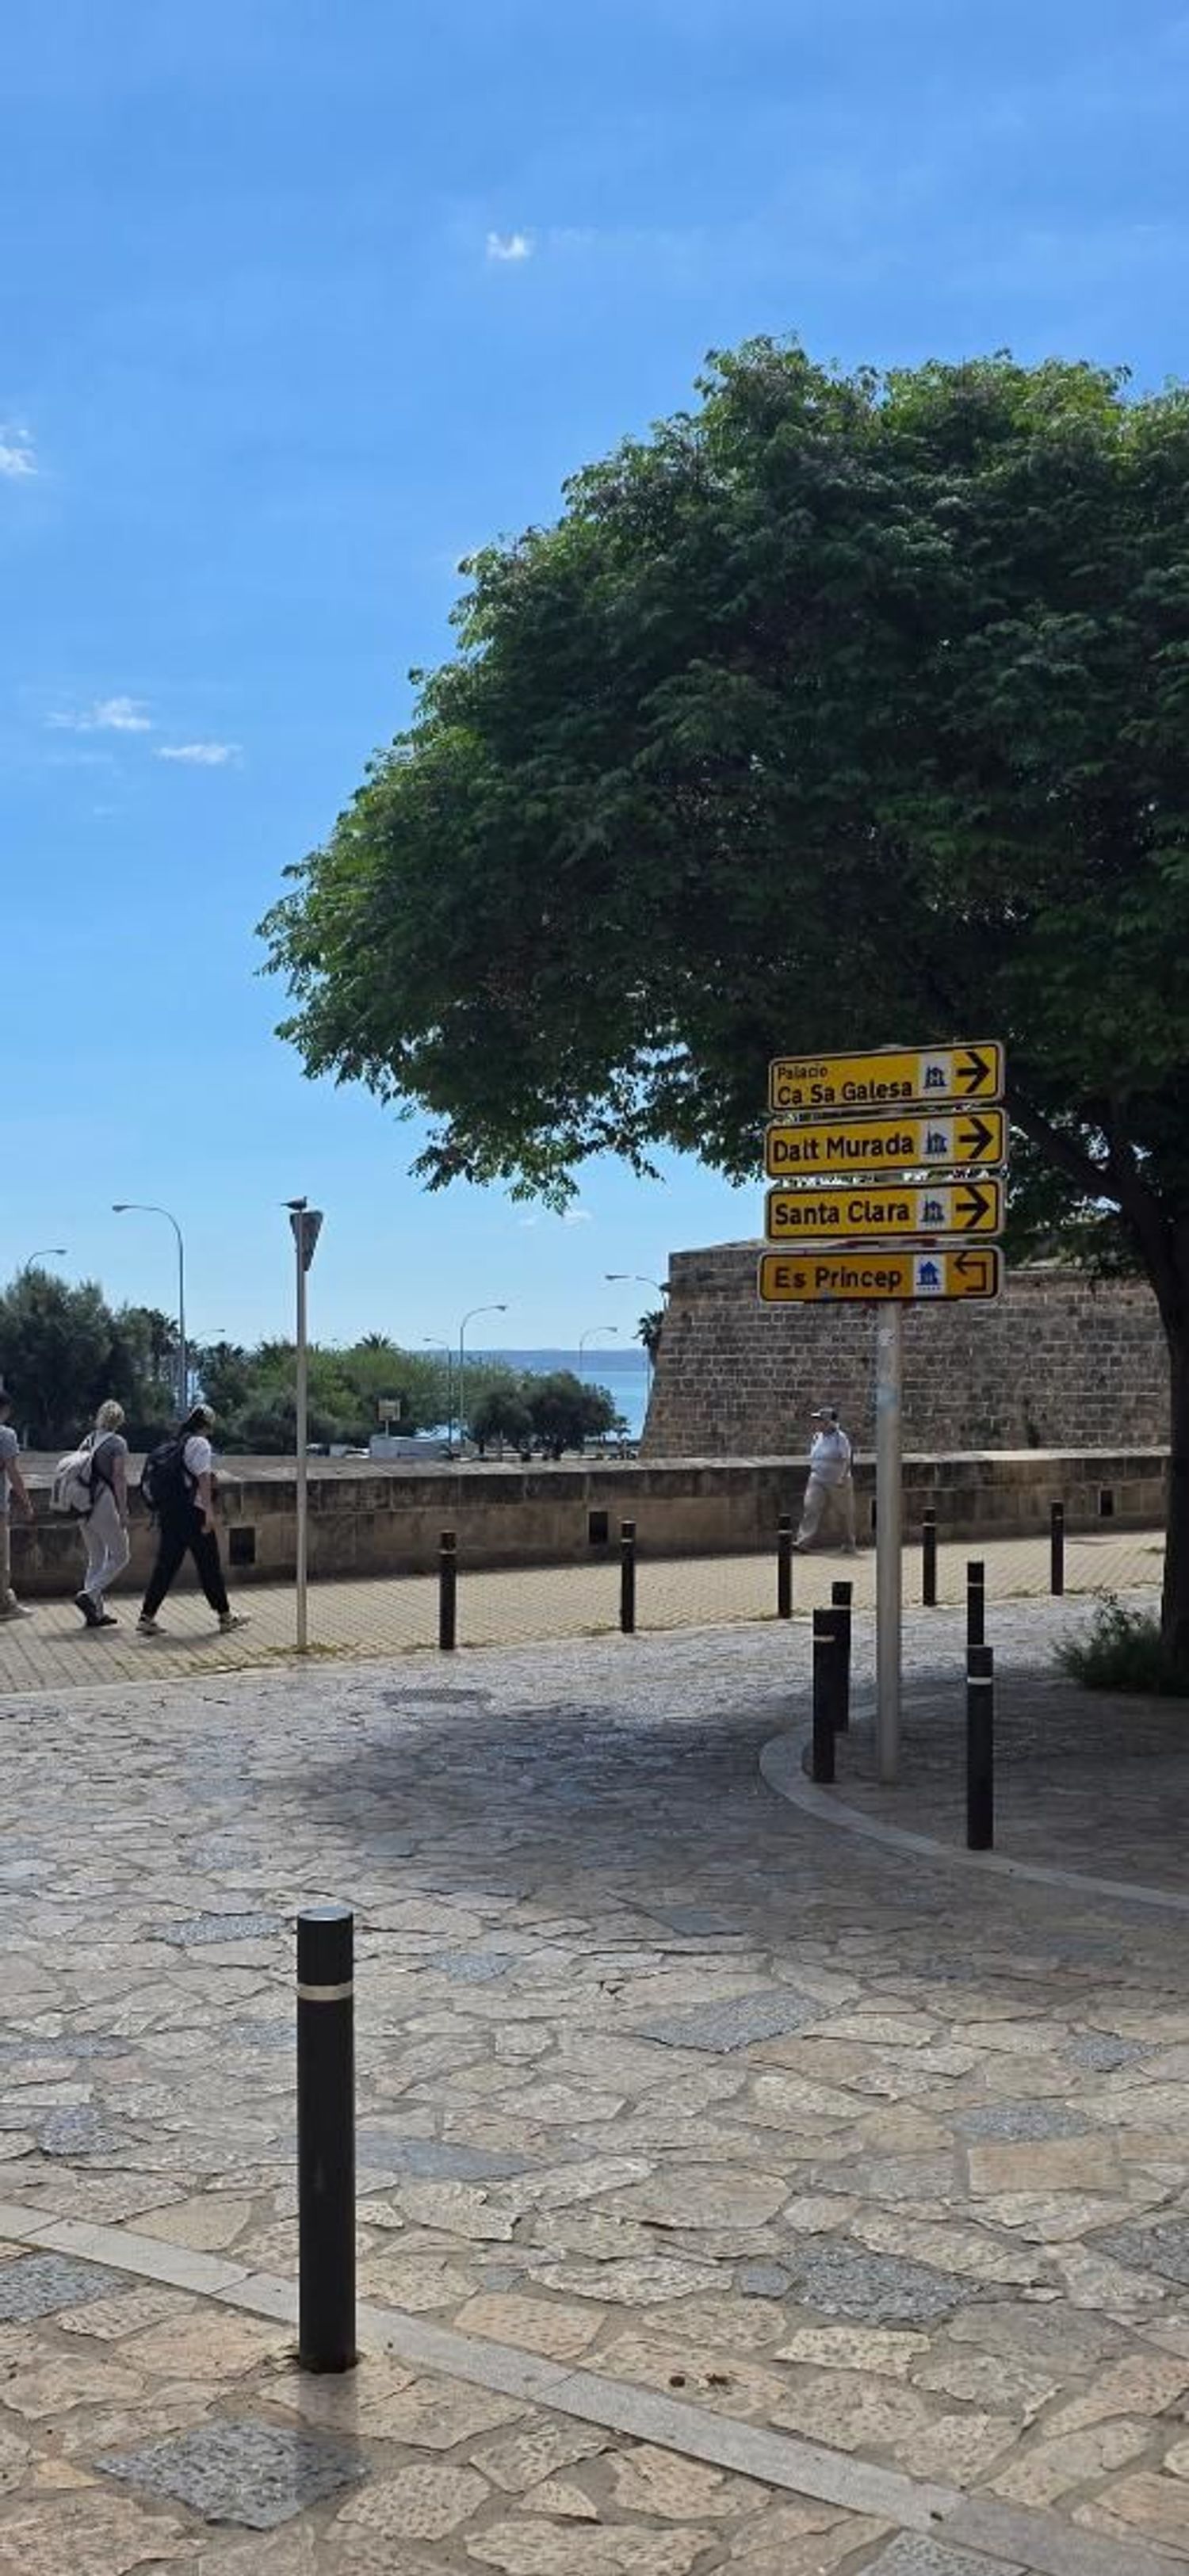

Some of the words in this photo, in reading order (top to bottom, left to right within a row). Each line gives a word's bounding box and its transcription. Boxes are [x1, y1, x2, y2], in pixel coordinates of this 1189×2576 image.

[778, 1064, 828, 1080] Palacio
[778, 1086, 802, 1105] Ca
[811, 1084, 835, 1103] Sa
[842, 1079, 912, 1101] Galesa
[774, 1137, 820, 1163] Dalt
[827, 1133, 914, 1159] Murada
[775, 1202, 839, 1225] Santa
[848, 1200, 909, 1222] Clara
[774, 1267, 806, 1288] Es
